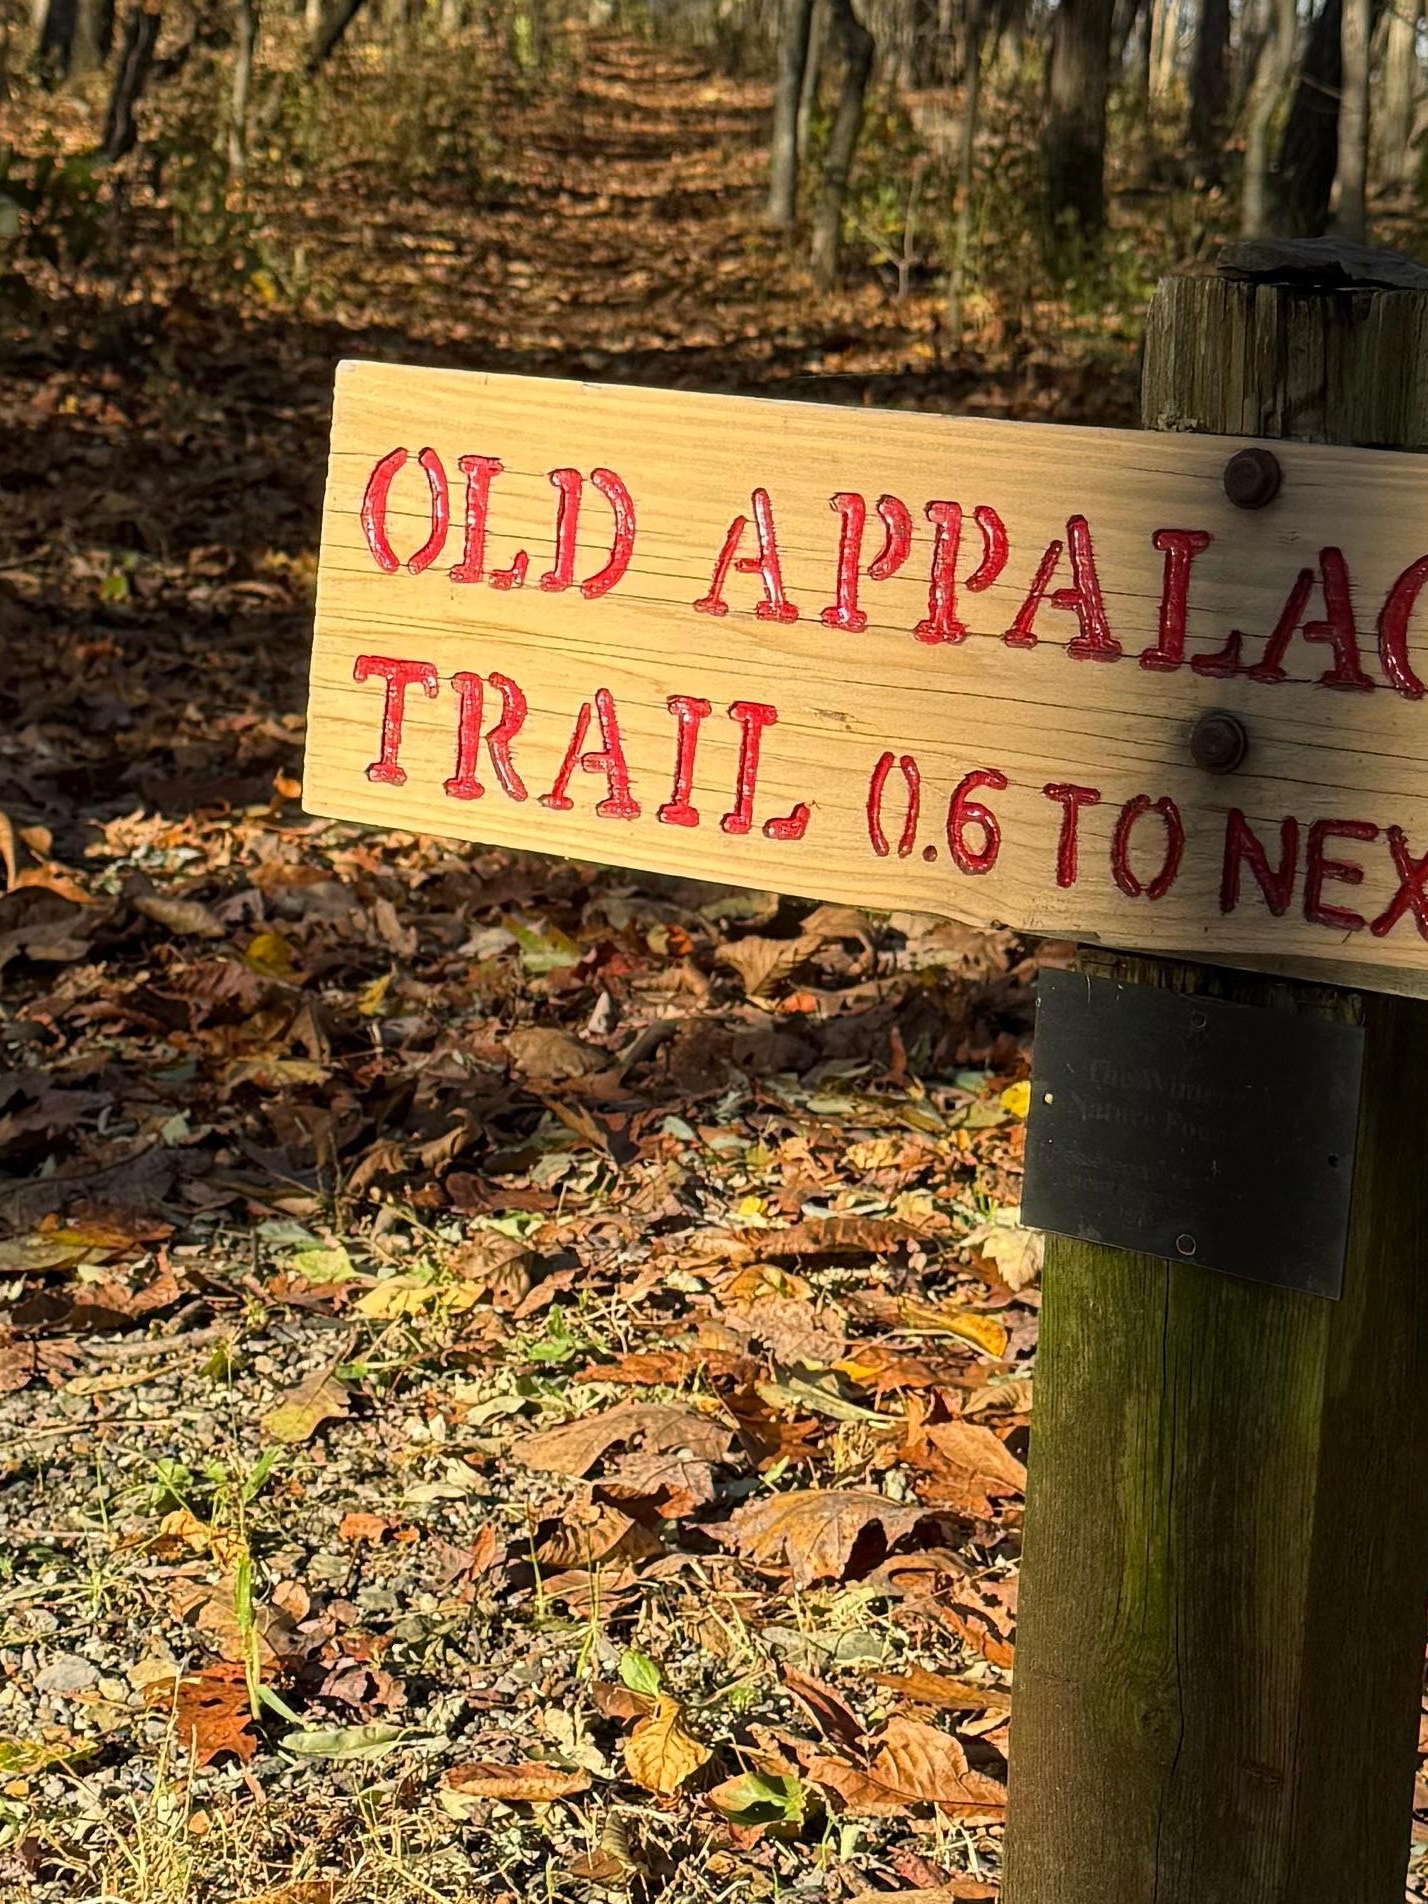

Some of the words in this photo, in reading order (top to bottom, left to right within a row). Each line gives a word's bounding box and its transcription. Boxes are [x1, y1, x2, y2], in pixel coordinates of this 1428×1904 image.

[359, 444, 639, 600] OLD
[351, 652, 811, 842] TRAIL
[866, 751, 1006, 876] 0.6
[1043, 780, 1184, 900] TO
